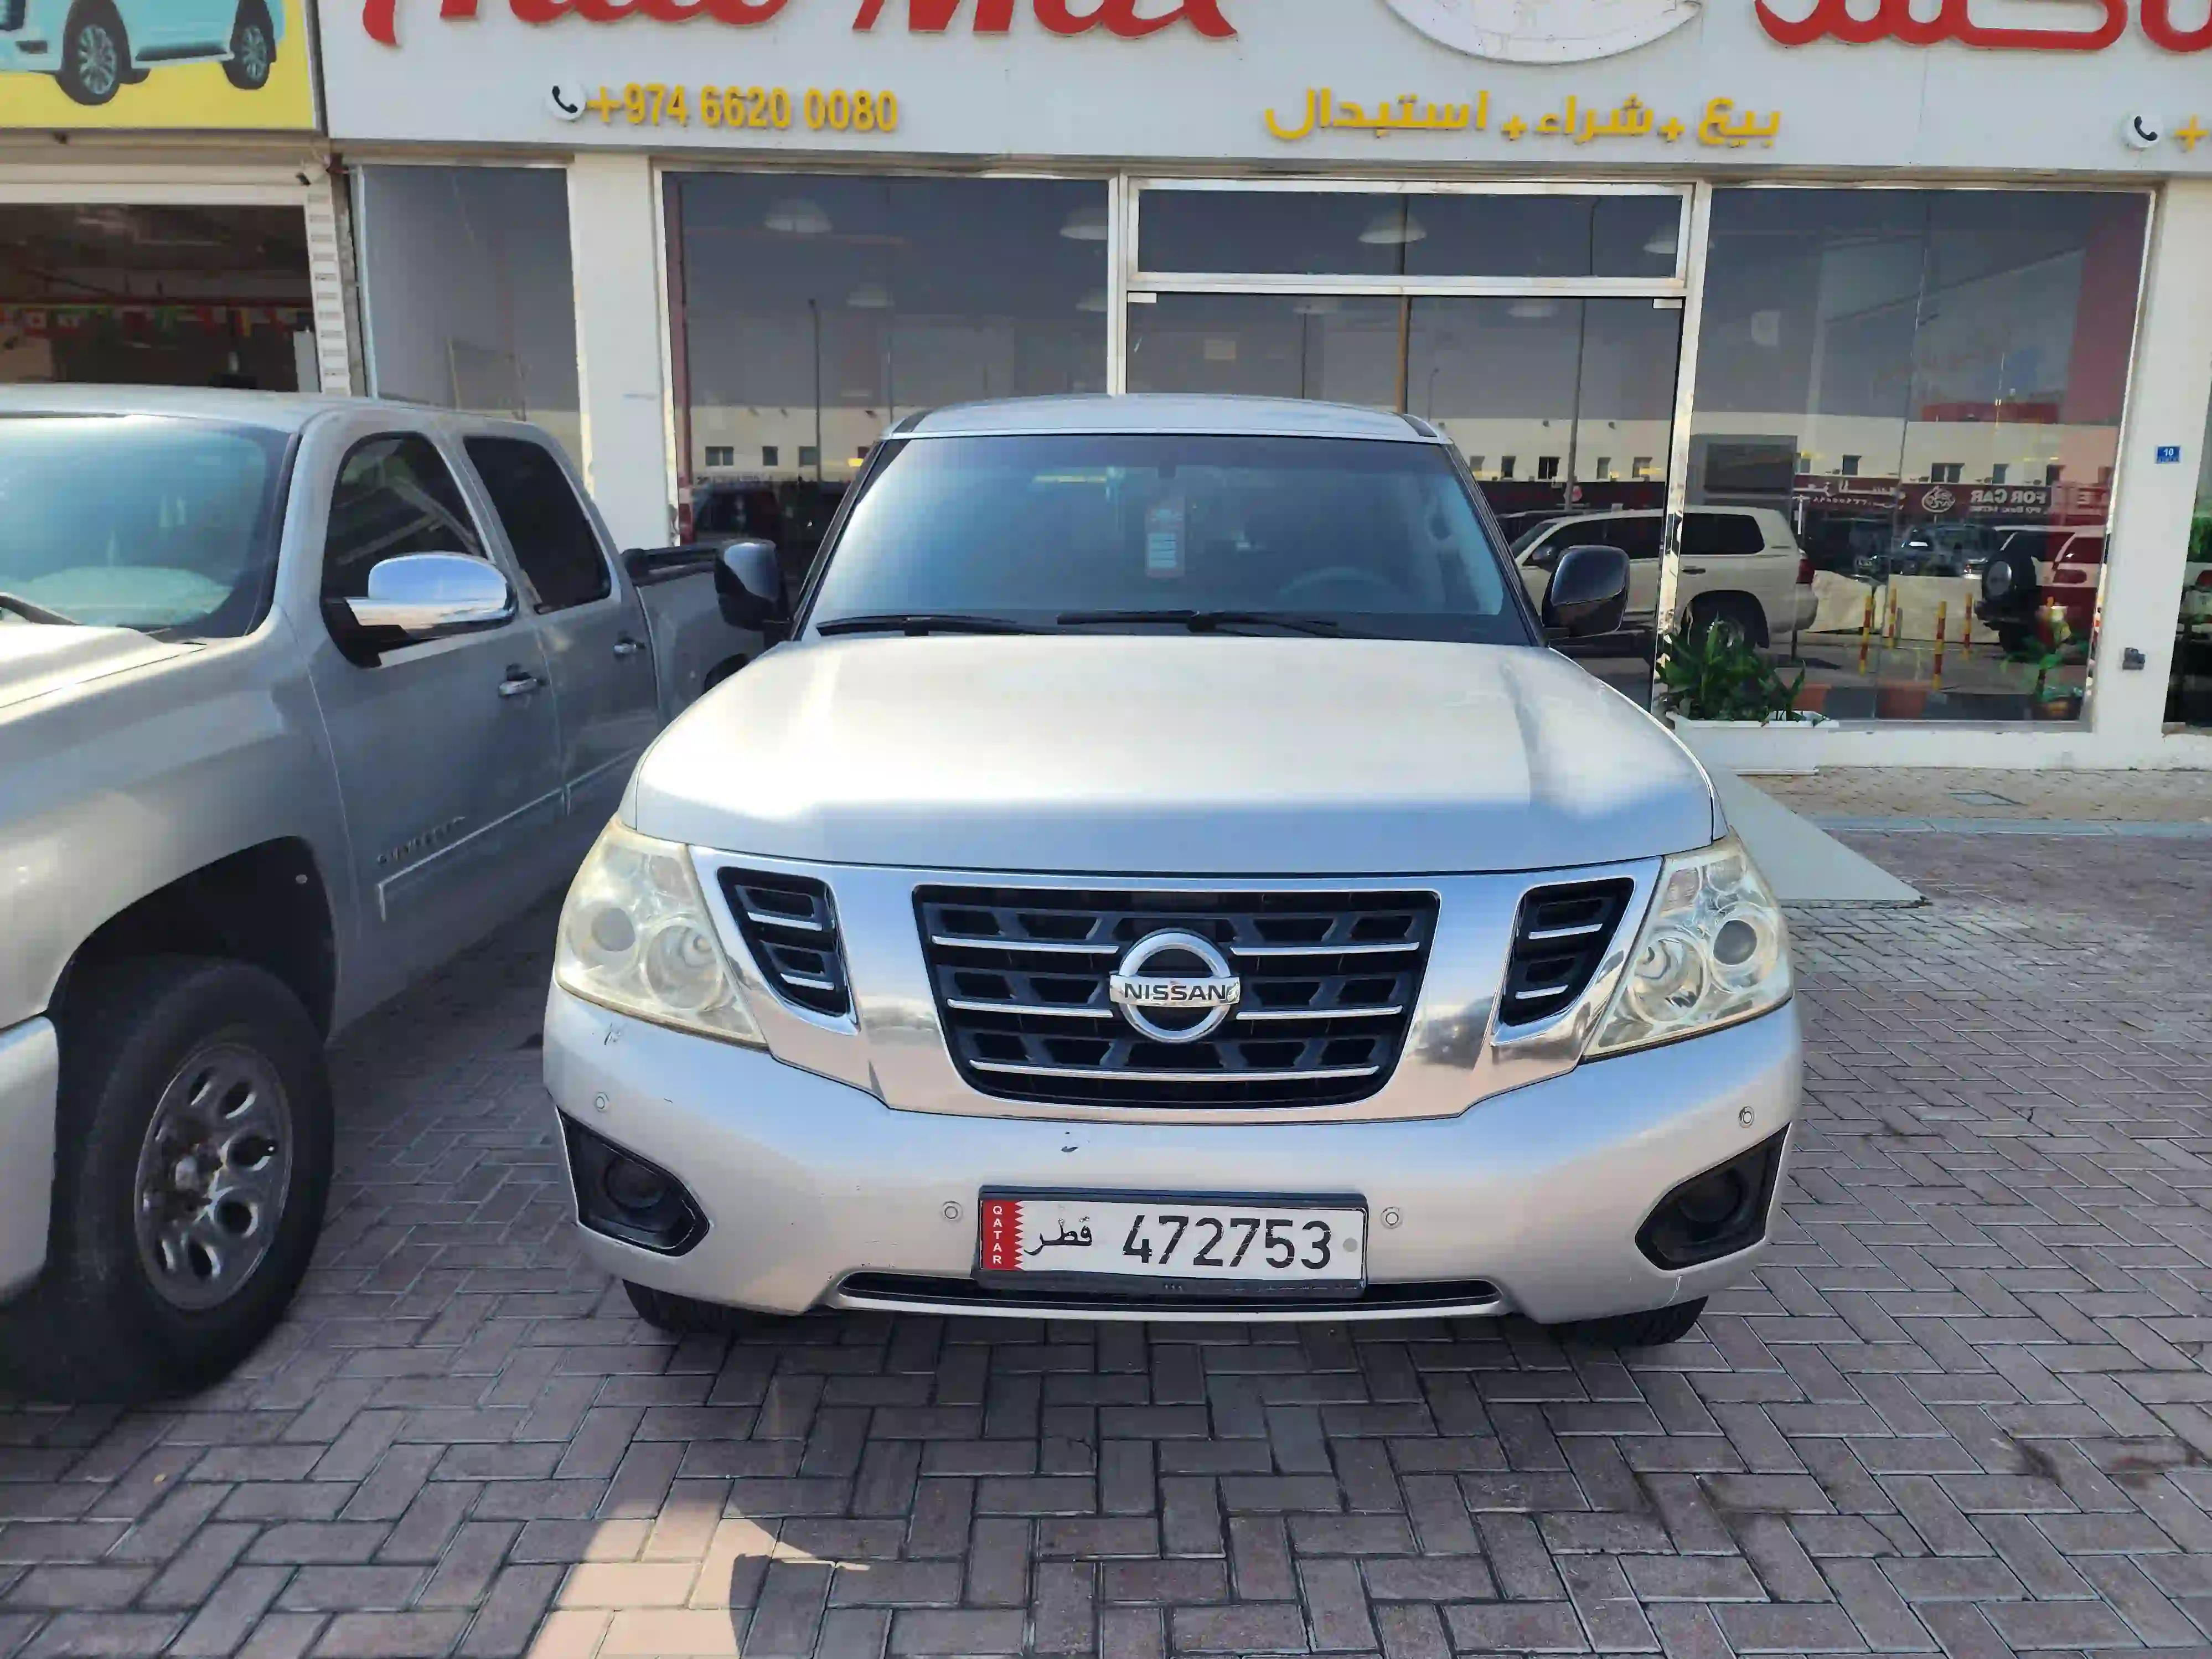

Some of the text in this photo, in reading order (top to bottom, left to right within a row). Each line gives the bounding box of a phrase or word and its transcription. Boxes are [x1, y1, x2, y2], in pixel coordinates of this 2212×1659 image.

[587, 83, 898, 132] +974 6620 0080
[1264, 87, 1490, 140] استبدال
[1536, 93, 1654, 143] شراء
[1698, 97, 1781, 147] بيع
[1124, 983, 1225, 1000] NISSAN
[993, 1205, 1002, 1264] QATAR
[1024, 1215, 1093, 1256] قطر
[1122, 1215, 1331, 1269] 472753
